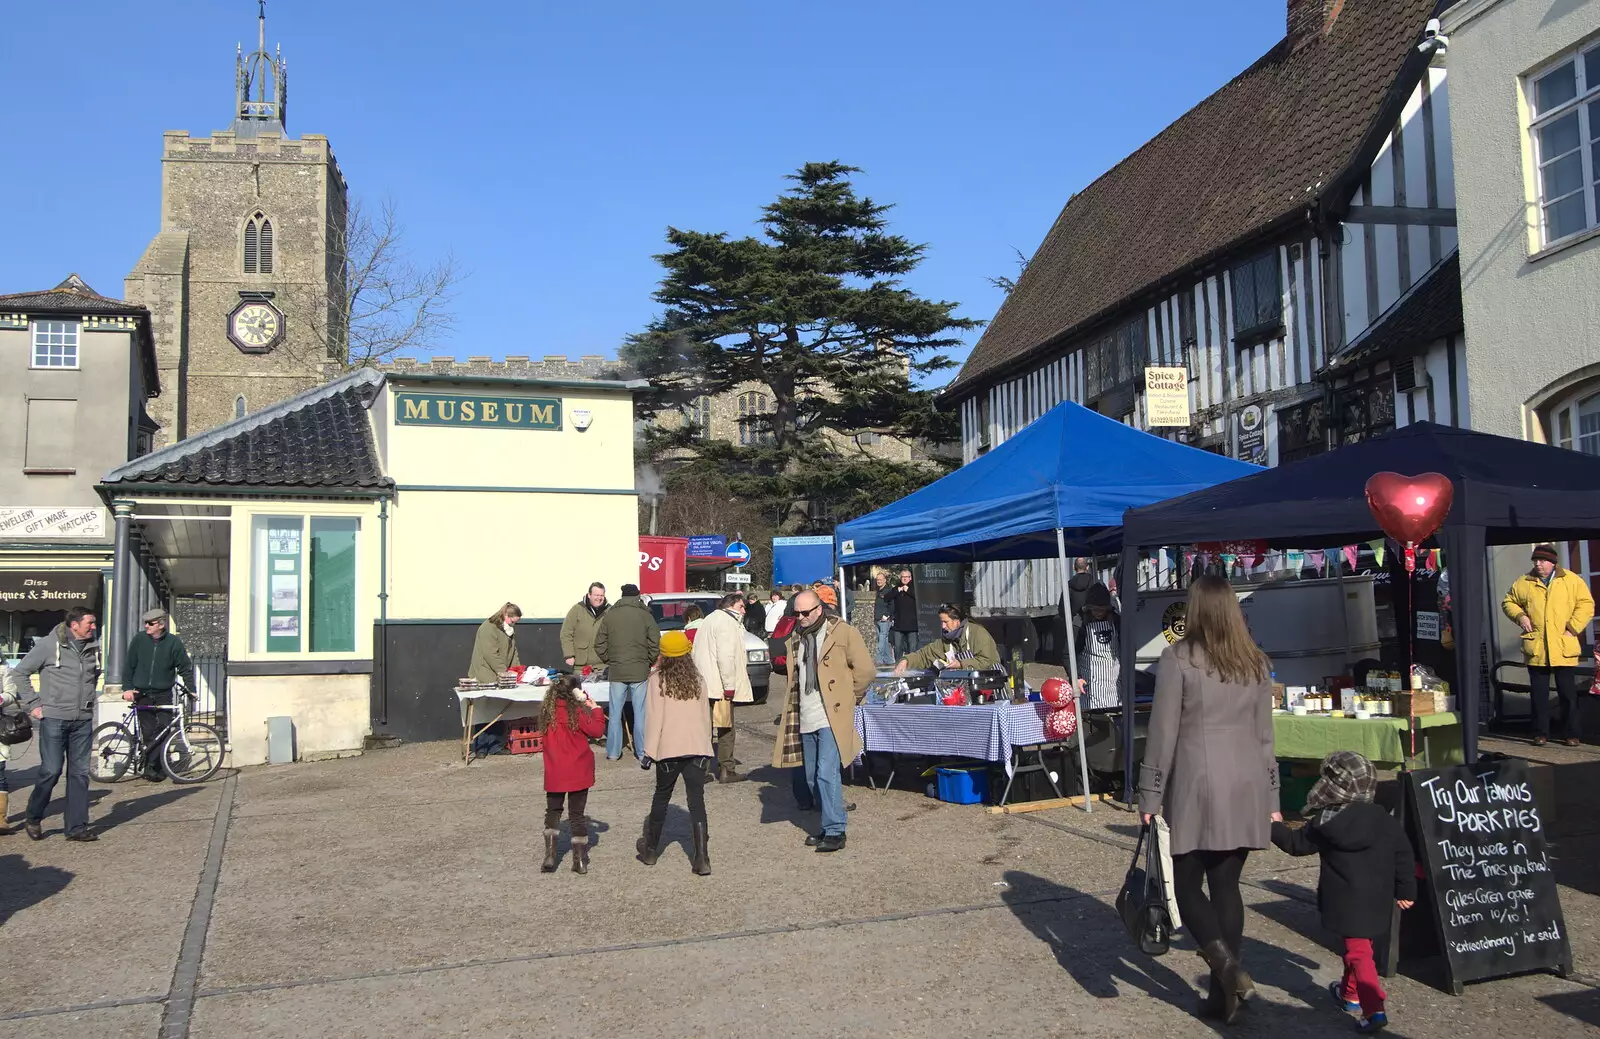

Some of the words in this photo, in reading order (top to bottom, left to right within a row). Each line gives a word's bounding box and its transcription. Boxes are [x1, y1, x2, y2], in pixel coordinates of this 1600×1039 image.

[1148, 371, 1175, 381] Spice
[1148, 381, 1185, 391] Cottage
[403, 398, 555, 424] MUSEUM
[0, 509, 35, 531] EWELLERY
[25, 519, 44, 533] GIFT
[44, 509, 68, 525] WARE
[58, 510, 98, 533] WATCHES
[27, 589, 39, 599] &
[40, 589, 88, 599] Interiors
[1421, 776, 1456, 823] Try
[1455, 779, 1480, 804] Our
[1456, 809, 1504, 833] PORK
[1503, 808, 1540, 833] PIES
[1438, 840, 1475, 867] They
[1478, 843, 1509, 856] were
[1512, 840, 1528, 855] in
[1442, 864, 1476, 881] The
[1476, 860, 1508, 878] Times
[1509, 864, 1528, 886] you
[1475, 887, 1504, 904] Coren
[1507, 889, 1535, 909] gave
[1450, 911, 1484, 927] them
[1523, 930, 1537, 943] he
[1537, 920, 1560, 940] said
